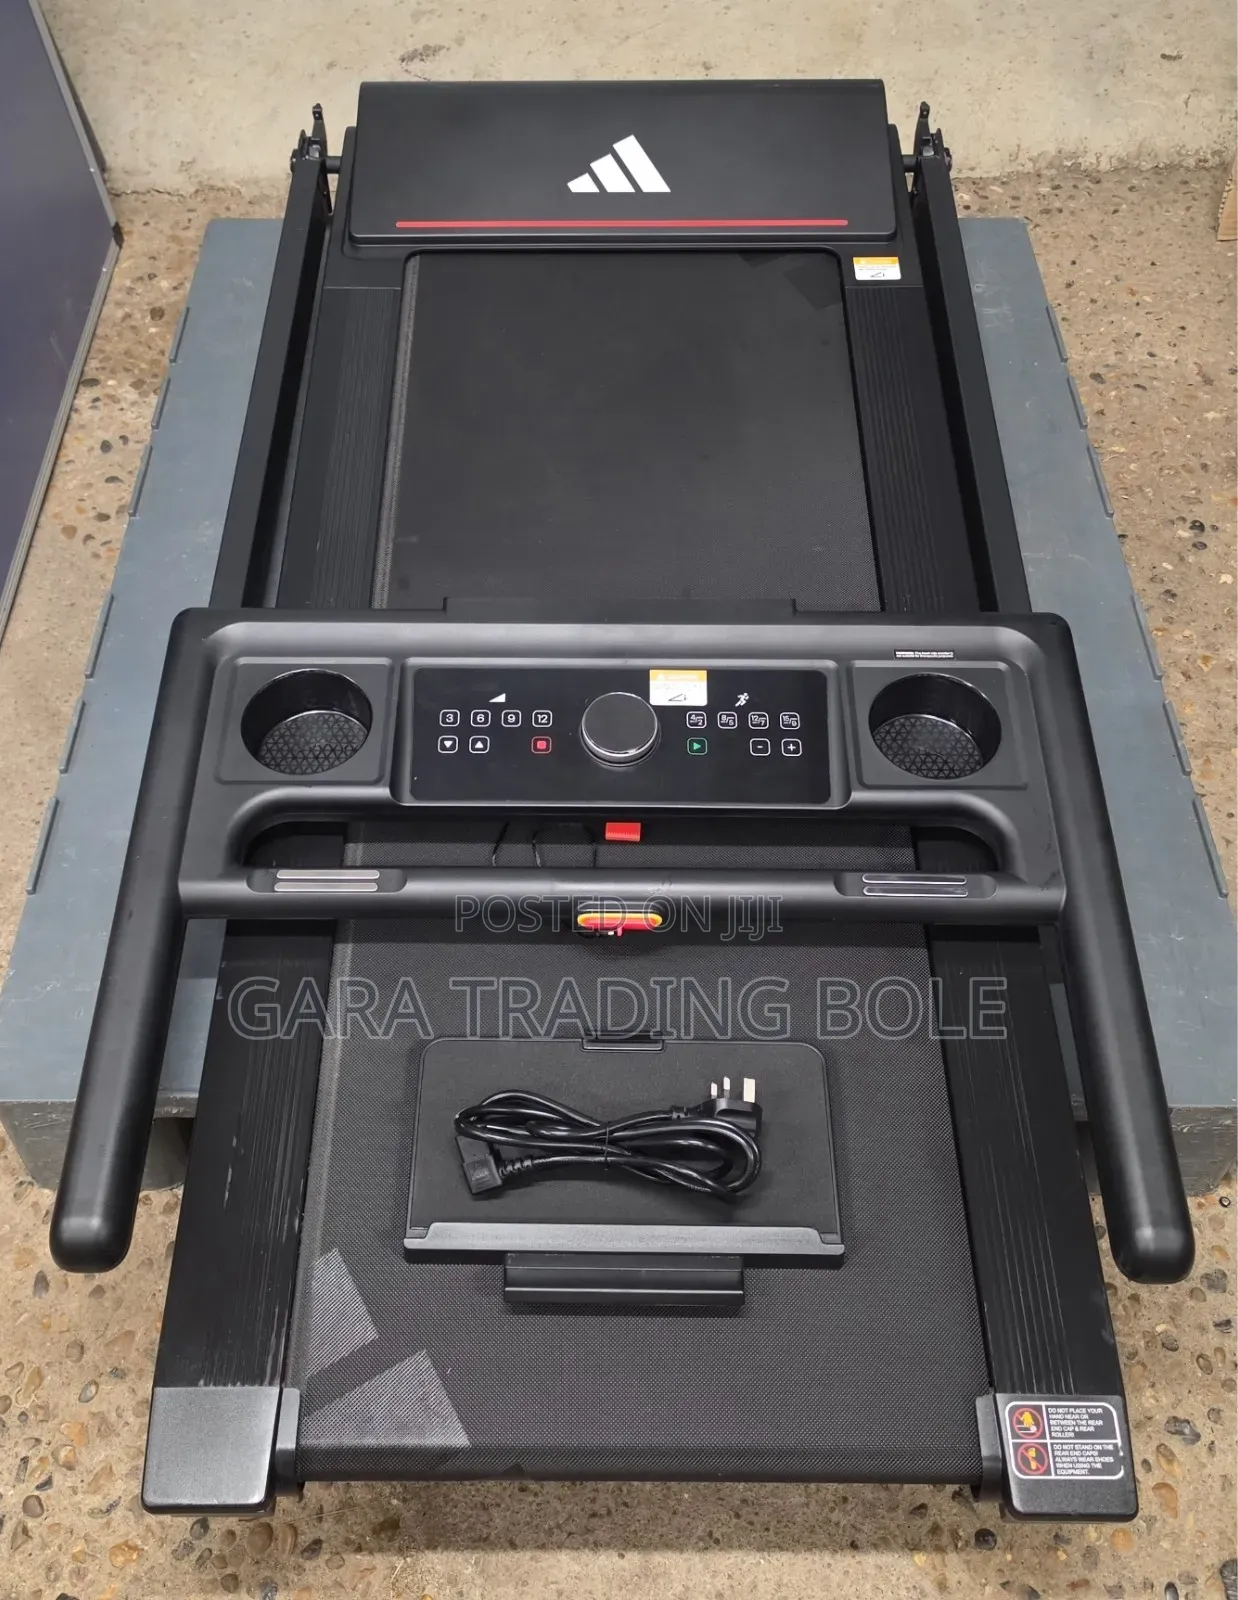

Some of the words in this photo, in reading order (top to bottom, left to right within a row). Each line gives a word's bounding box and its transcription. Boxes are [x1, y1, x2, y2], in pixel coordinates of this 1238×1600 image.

[446, 714, 454, 722] 3
[476, 714, 485, 723] 6
[508, 714, 516, 723] 9
[537, 714, 548, 723] 12
